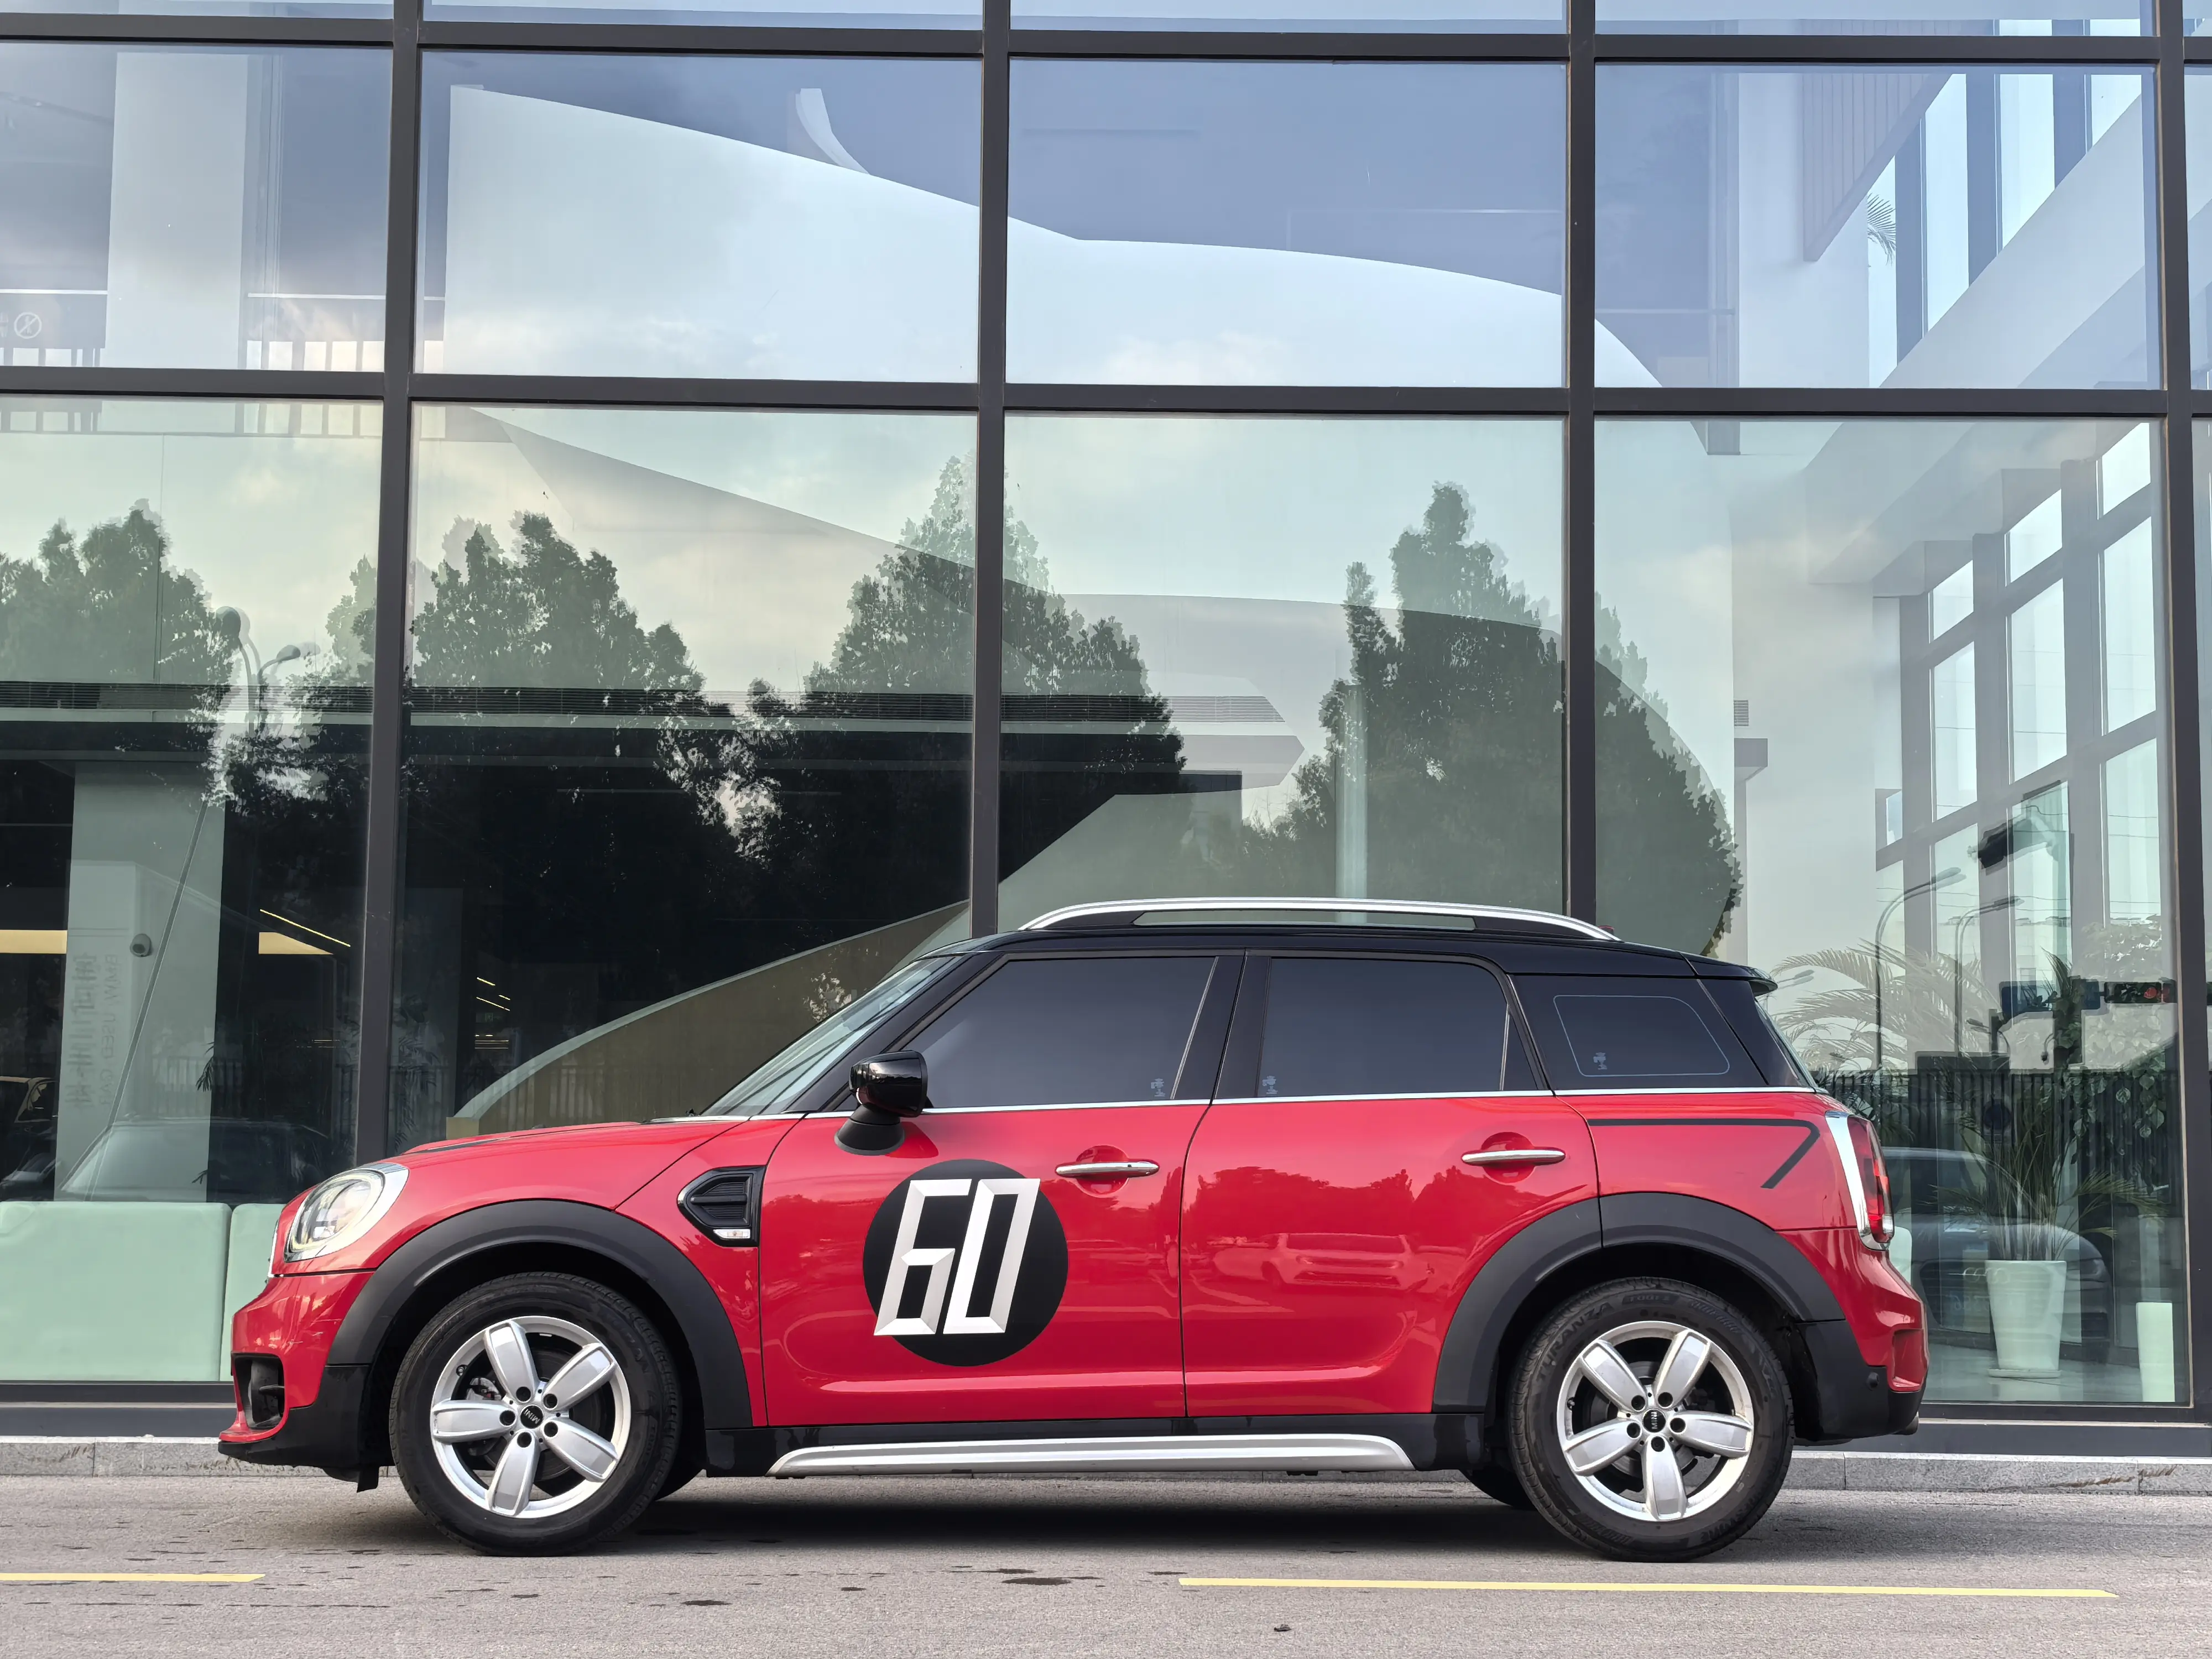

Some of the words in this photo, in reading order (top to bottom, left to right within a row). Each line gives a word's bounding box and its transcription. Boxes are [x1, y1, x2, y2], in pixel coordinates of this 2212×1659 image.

[874, 1178, 1040, 1335] 60
[1536, 1302, 1615, 1382] TURANZA
[524, 1408, 540, 1424] MINI
